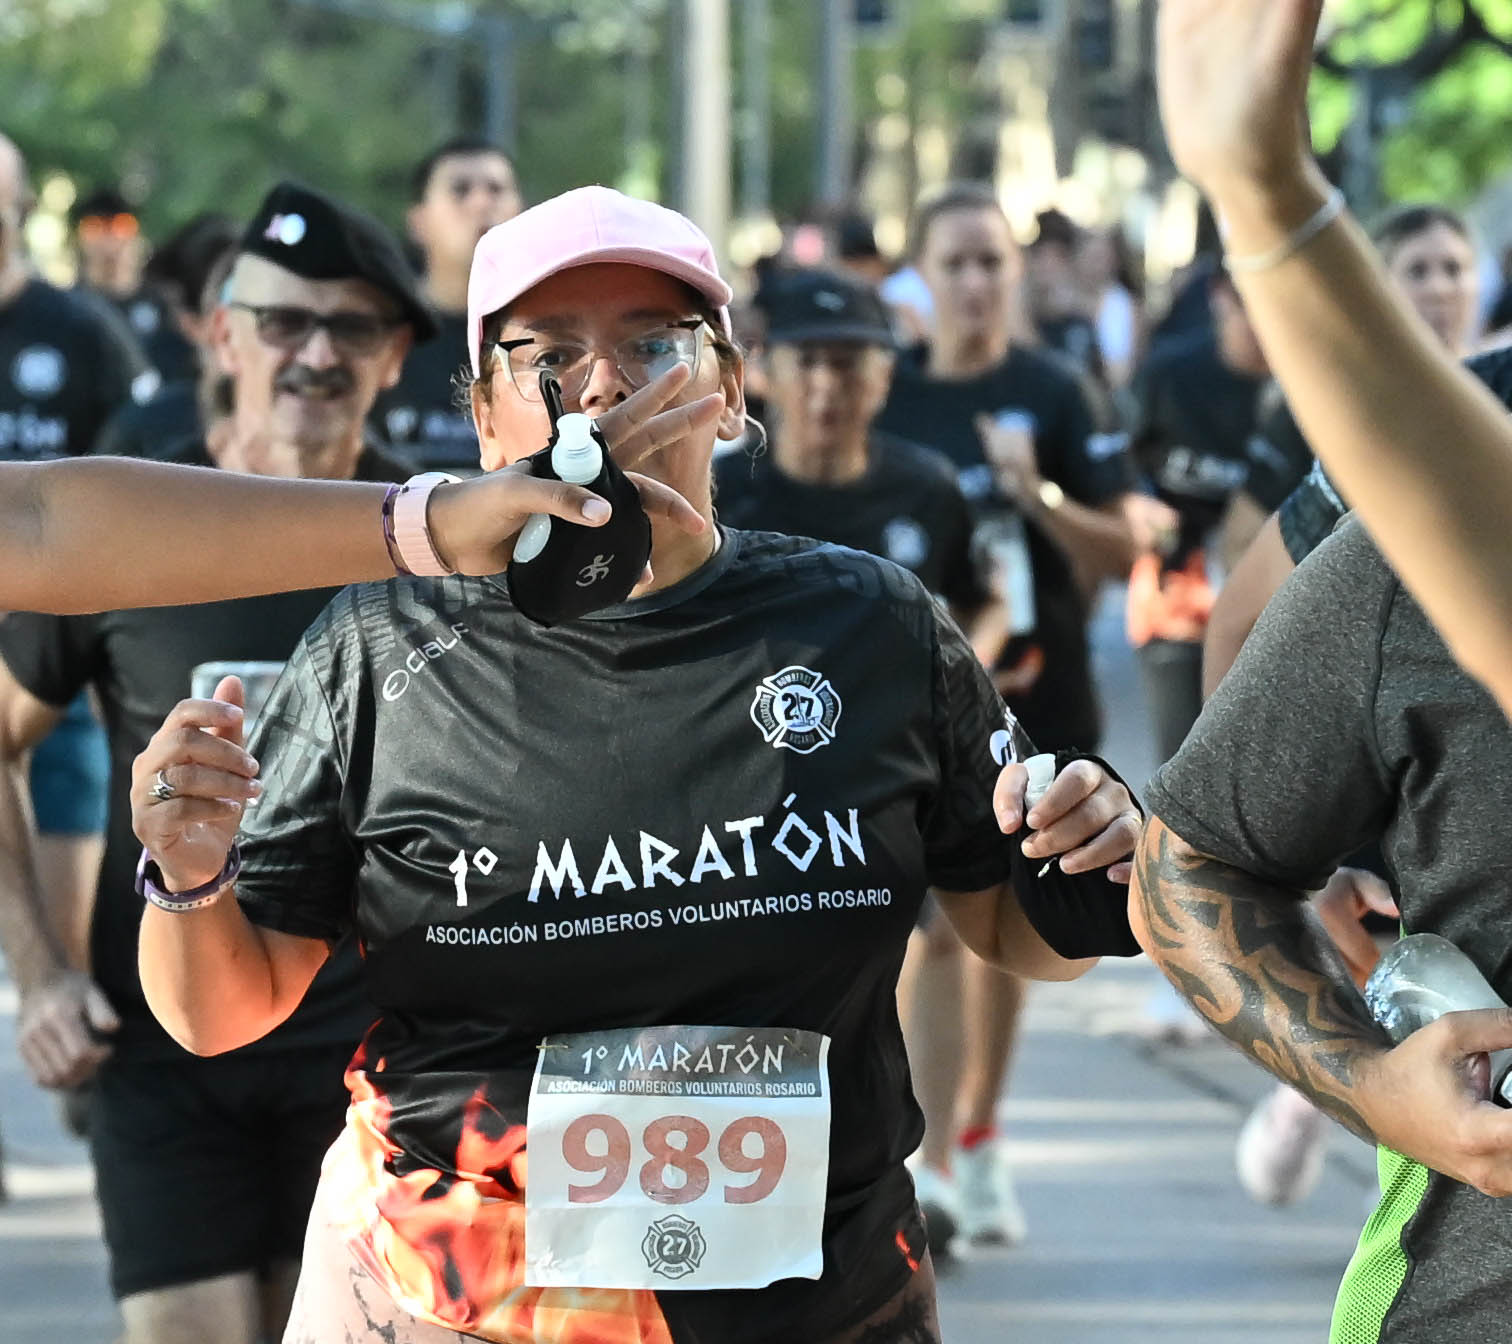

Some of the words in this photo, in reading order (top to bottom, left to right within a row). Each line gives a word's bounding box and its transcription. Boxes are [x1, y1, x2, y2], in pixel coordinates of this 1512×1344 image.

[781, 692, 815, 721] 27
[527, 792, 867, 904] MARATÓN
[425, 920, 539, 946] ASOCIACIÓN
[544, 910, 664, 941] BOMBEROS
[668, 893, 813, 926] VOLUNTARIOS
[818, 887, 892, 910] ROSARIO
[616, 1035, 786, 1075] MARATÓN
[547, 1079, 616, 1094] ASOCIACIÓN
[619, 1080, 683, 1095] BOMBEROS
[684, 1081, 763, 1096] VOLUNTARIOS
[764, 1082, 816, 1097] ROSARIO
[562, 1113, 787, 1205] 989
[662, 1234, 687, 1257] 27
